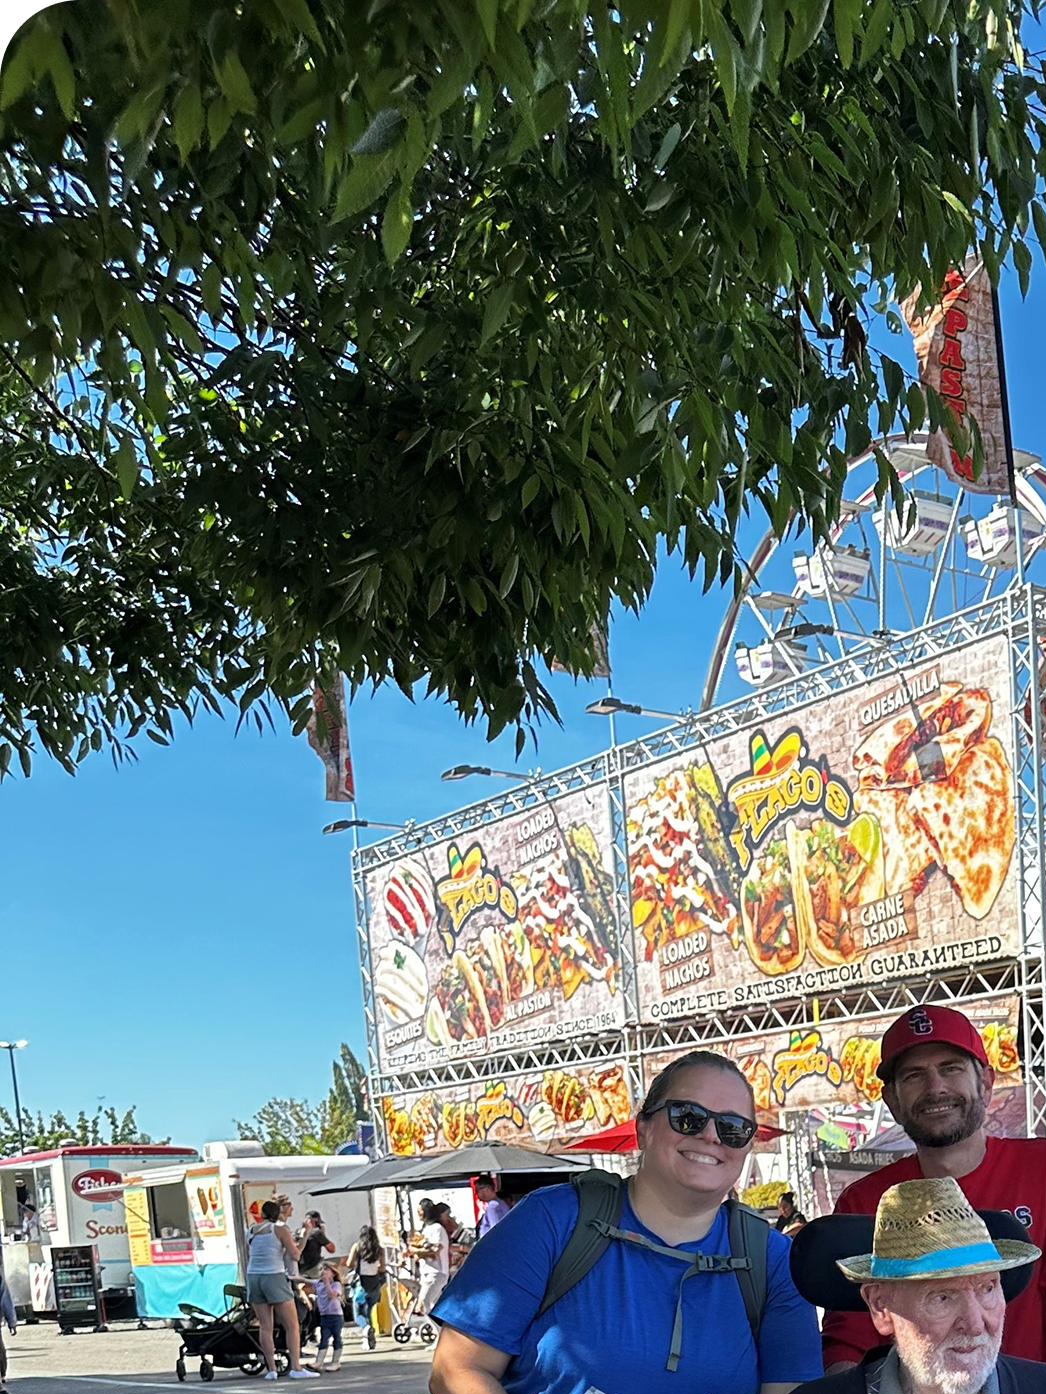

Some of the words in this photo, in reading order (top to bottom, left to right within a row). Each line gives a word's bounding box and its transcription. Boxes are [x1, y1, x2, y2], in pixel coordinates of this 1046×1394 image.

[861, 669, 941, 727] QUESADILLA
[516, 810, 556, 843] LOADED
[520, 832, 558, 865] NACHOS
[860, 898, 905, 927] CARNE
[661, 934, 708, 966] LOADED
[862, 921, 909, 950] ASADA
[651, 991, 728, 1018] COMPLETE
[734, 963, 864, 1001] SATISFACTION
[870, 936, 1003, 976] GUARANTEED
[665, 957, 711, 990] NACHOS
[490, 1025, 551, 1047] TRADITION
[556, 1018, 594, 1034] SINCE
[849, 1152, 873, 1165] ASADA
